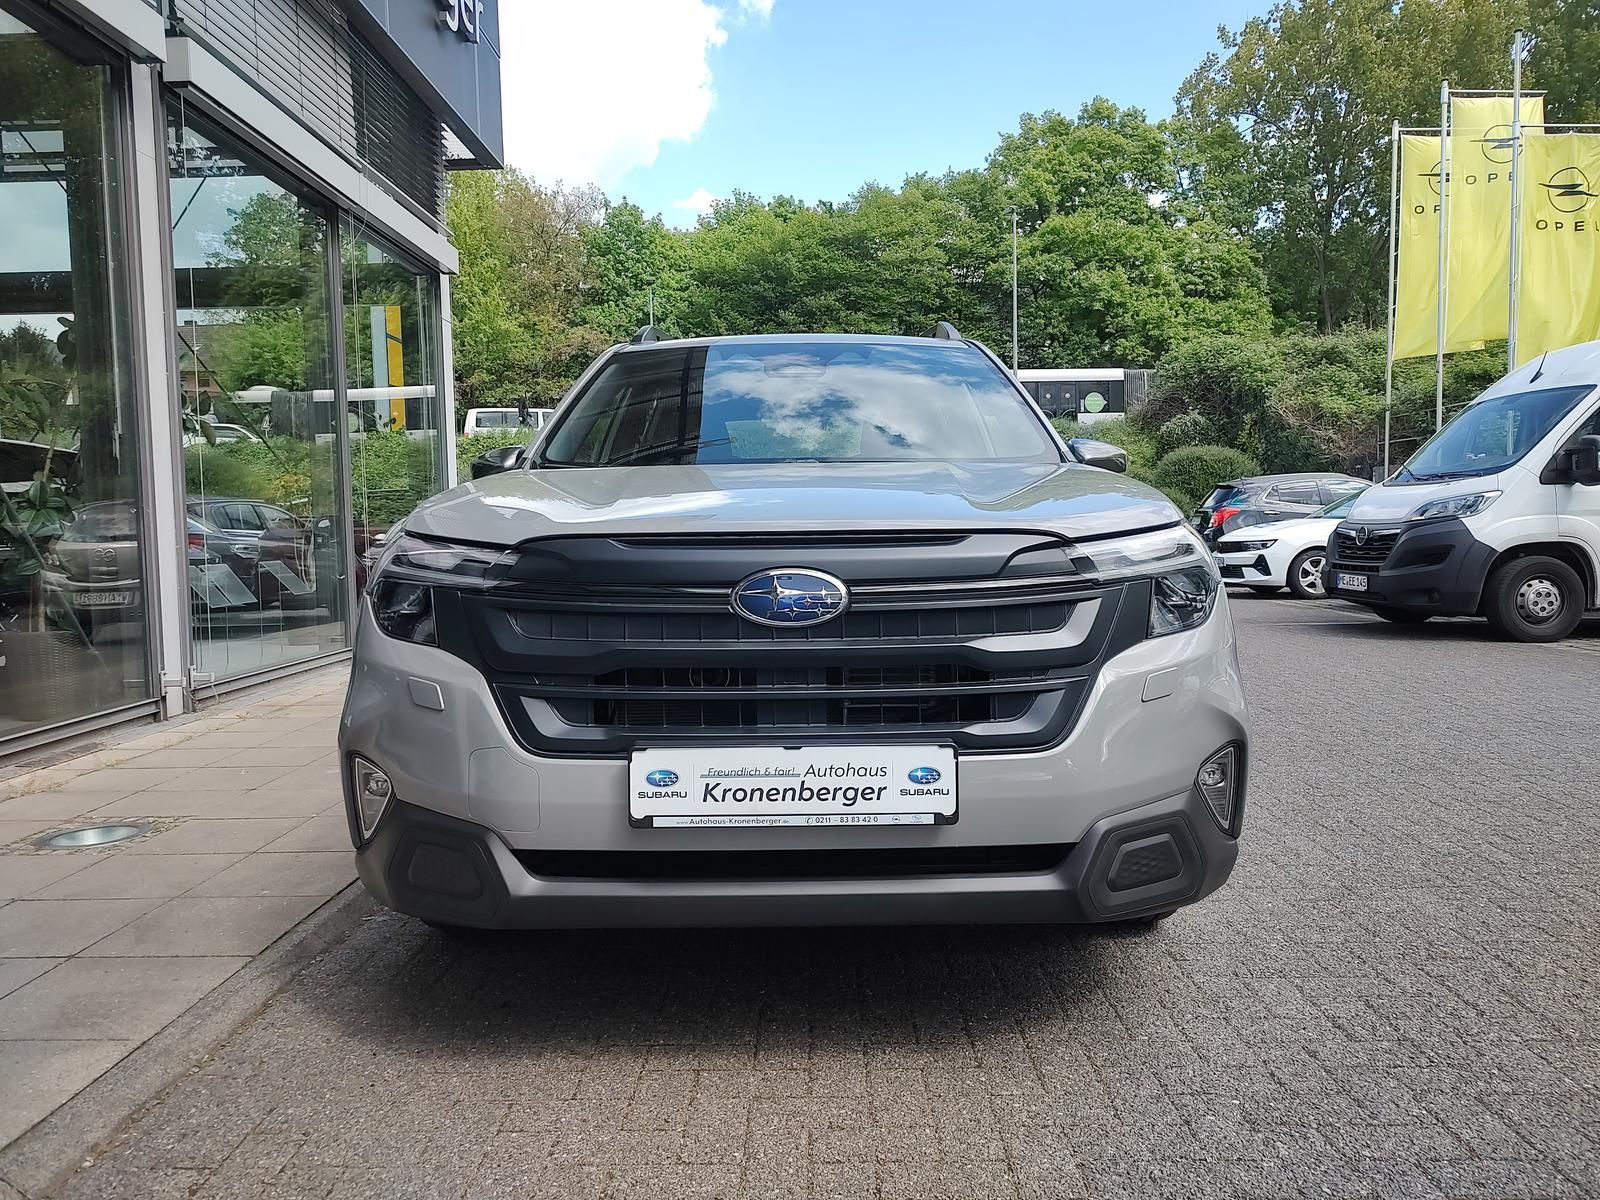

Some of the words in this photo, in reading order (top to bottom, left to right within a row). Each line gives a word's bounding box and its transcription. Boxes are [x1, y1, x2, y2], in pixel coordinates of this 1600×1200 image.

[707, 767, 760, 777] Freundlich
[764, 767, 771, 776] &
[773, 766, 795, 776] fair!
[803, 762, 887, 778] Autohaus
[637, 791, 688, 799] SUBARU
[702, 780, 888, 807] Kronenberger
[899, 788, 950, 796] SUBARU
